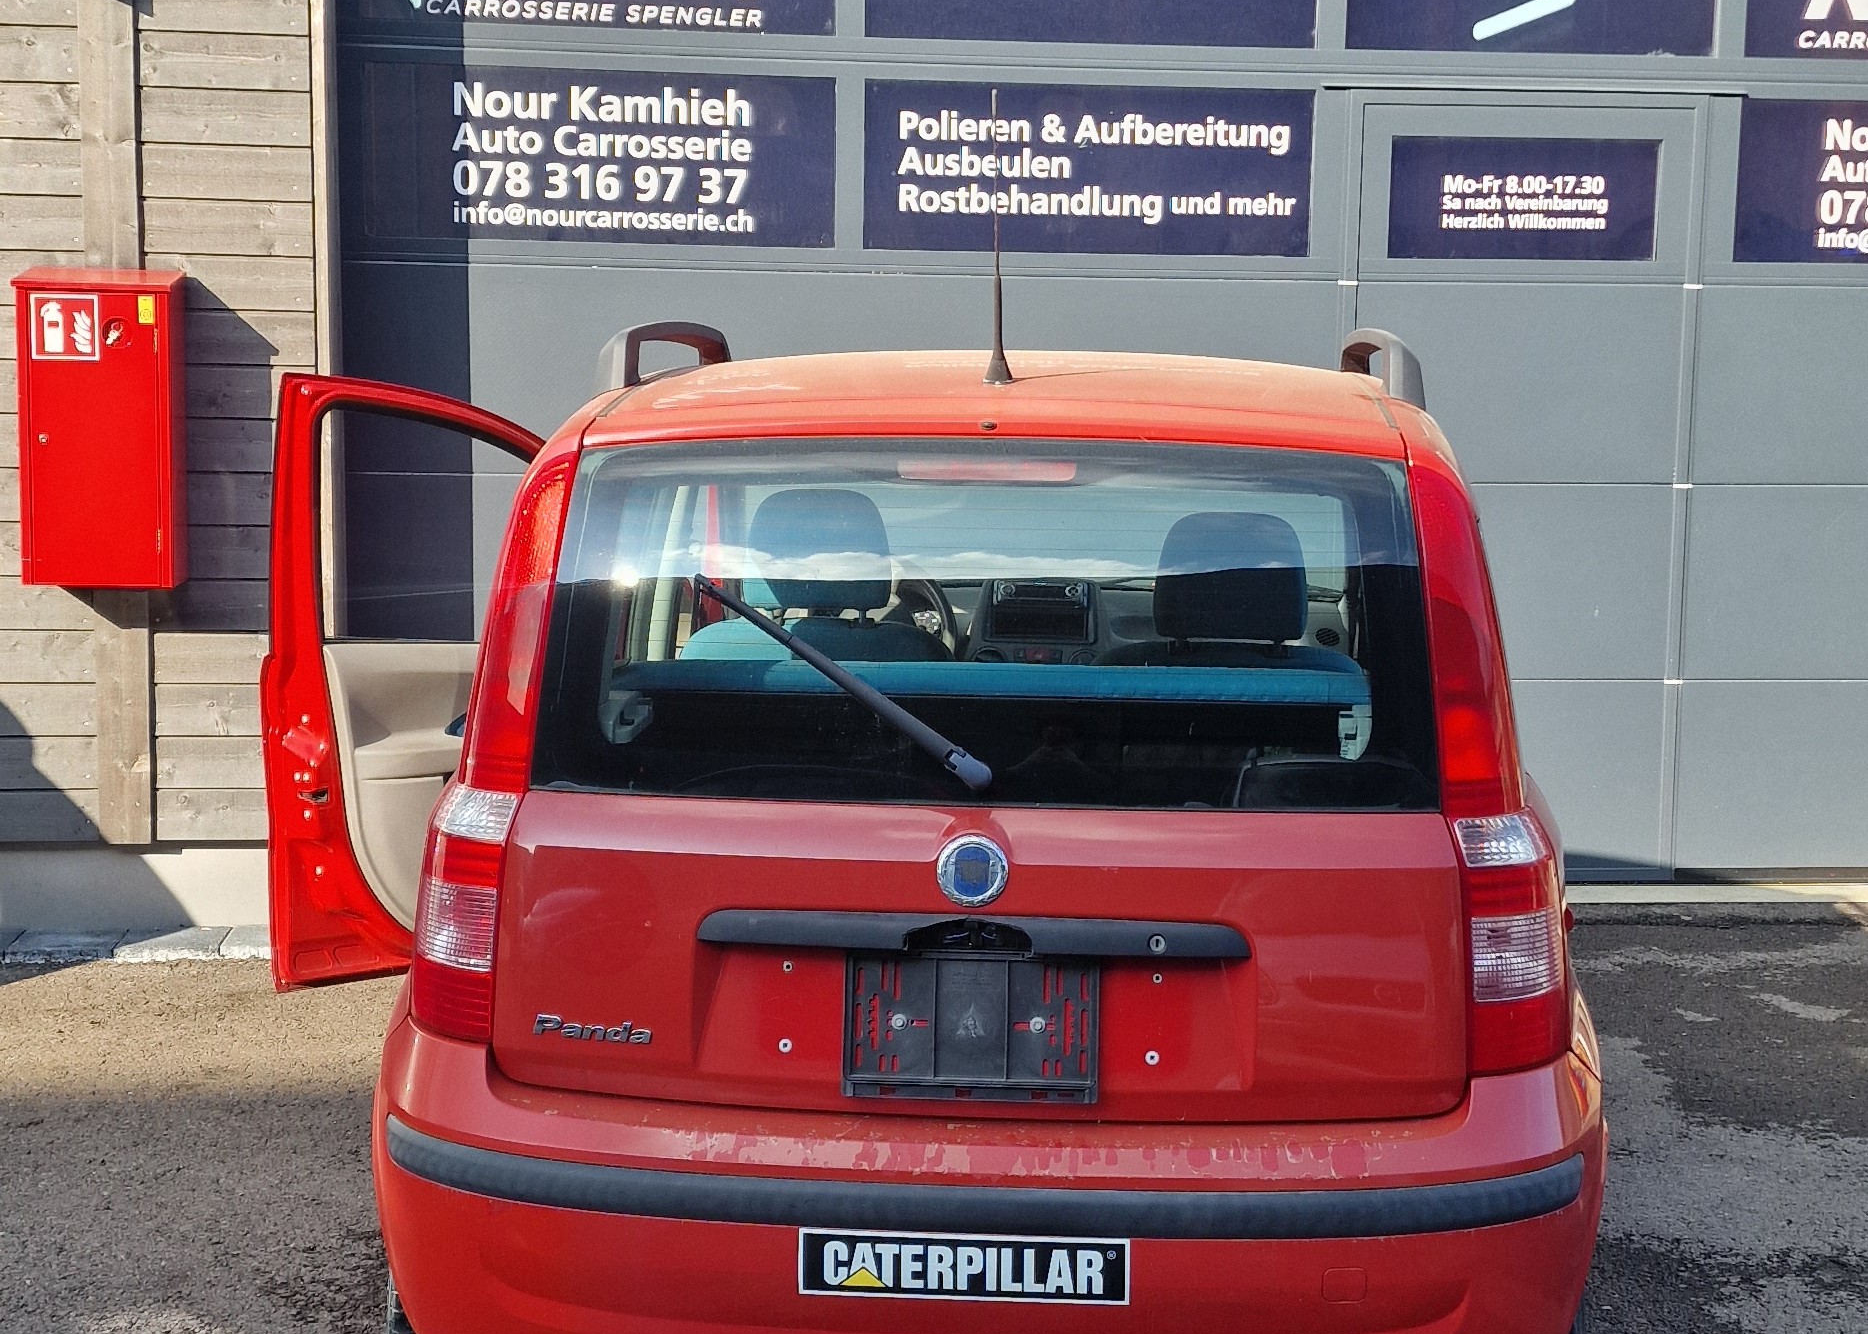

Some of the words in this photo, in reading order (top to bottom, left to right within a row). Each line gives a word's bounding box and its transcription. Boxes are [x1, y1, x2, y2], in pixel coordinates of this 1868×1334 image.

[624, 4, 763, 28] SPENGLER
[1798, 29, 1868, 50] CARR
[452, 81, 557, 120] Nour
[569, 86, 752, 128] Kamhieh
[451, 123, 543, 155] Auto
[552, 126, 752, 163] Carrosserie
[899, 110, 1030, 143] Polieren
[1041, 114, 1066, 144] &
[1073, 115, 1291, 155] Aufbereitung
[898, 147, 1071, 179] Ausbeulen
[1819, 154, 1868, 183] Au
[452, 161, 530, 198] 078
[543, 163, 620, 201] 316
[633, 166, 684, 202] 97
[697, 169, 748, 205] 37
[1443, 174, 1502, 194] Mo-Fr
[1505, 175, 1606, 196] 8.00-17.30
[452, 201, 754, 234] info@nourcarrosserie.ch
[899, 184, 1163, 225] Rostbehandlung
[1171, 192, 1221, 216] und
[1228, 192, 1297, 217] mehr
[1442, 194, 1462, 211] Sa
[1464, 195, 1502, 211] nach
[1505, 195, 1609, 215] Vereinbarung
[1820, 189, 1868, 225] 07
[1442, 213, 1505, 231] Herzlich
[1508, 214, 1606, 231] Willkommen
[532, 1013, 652, 1044] Panda
